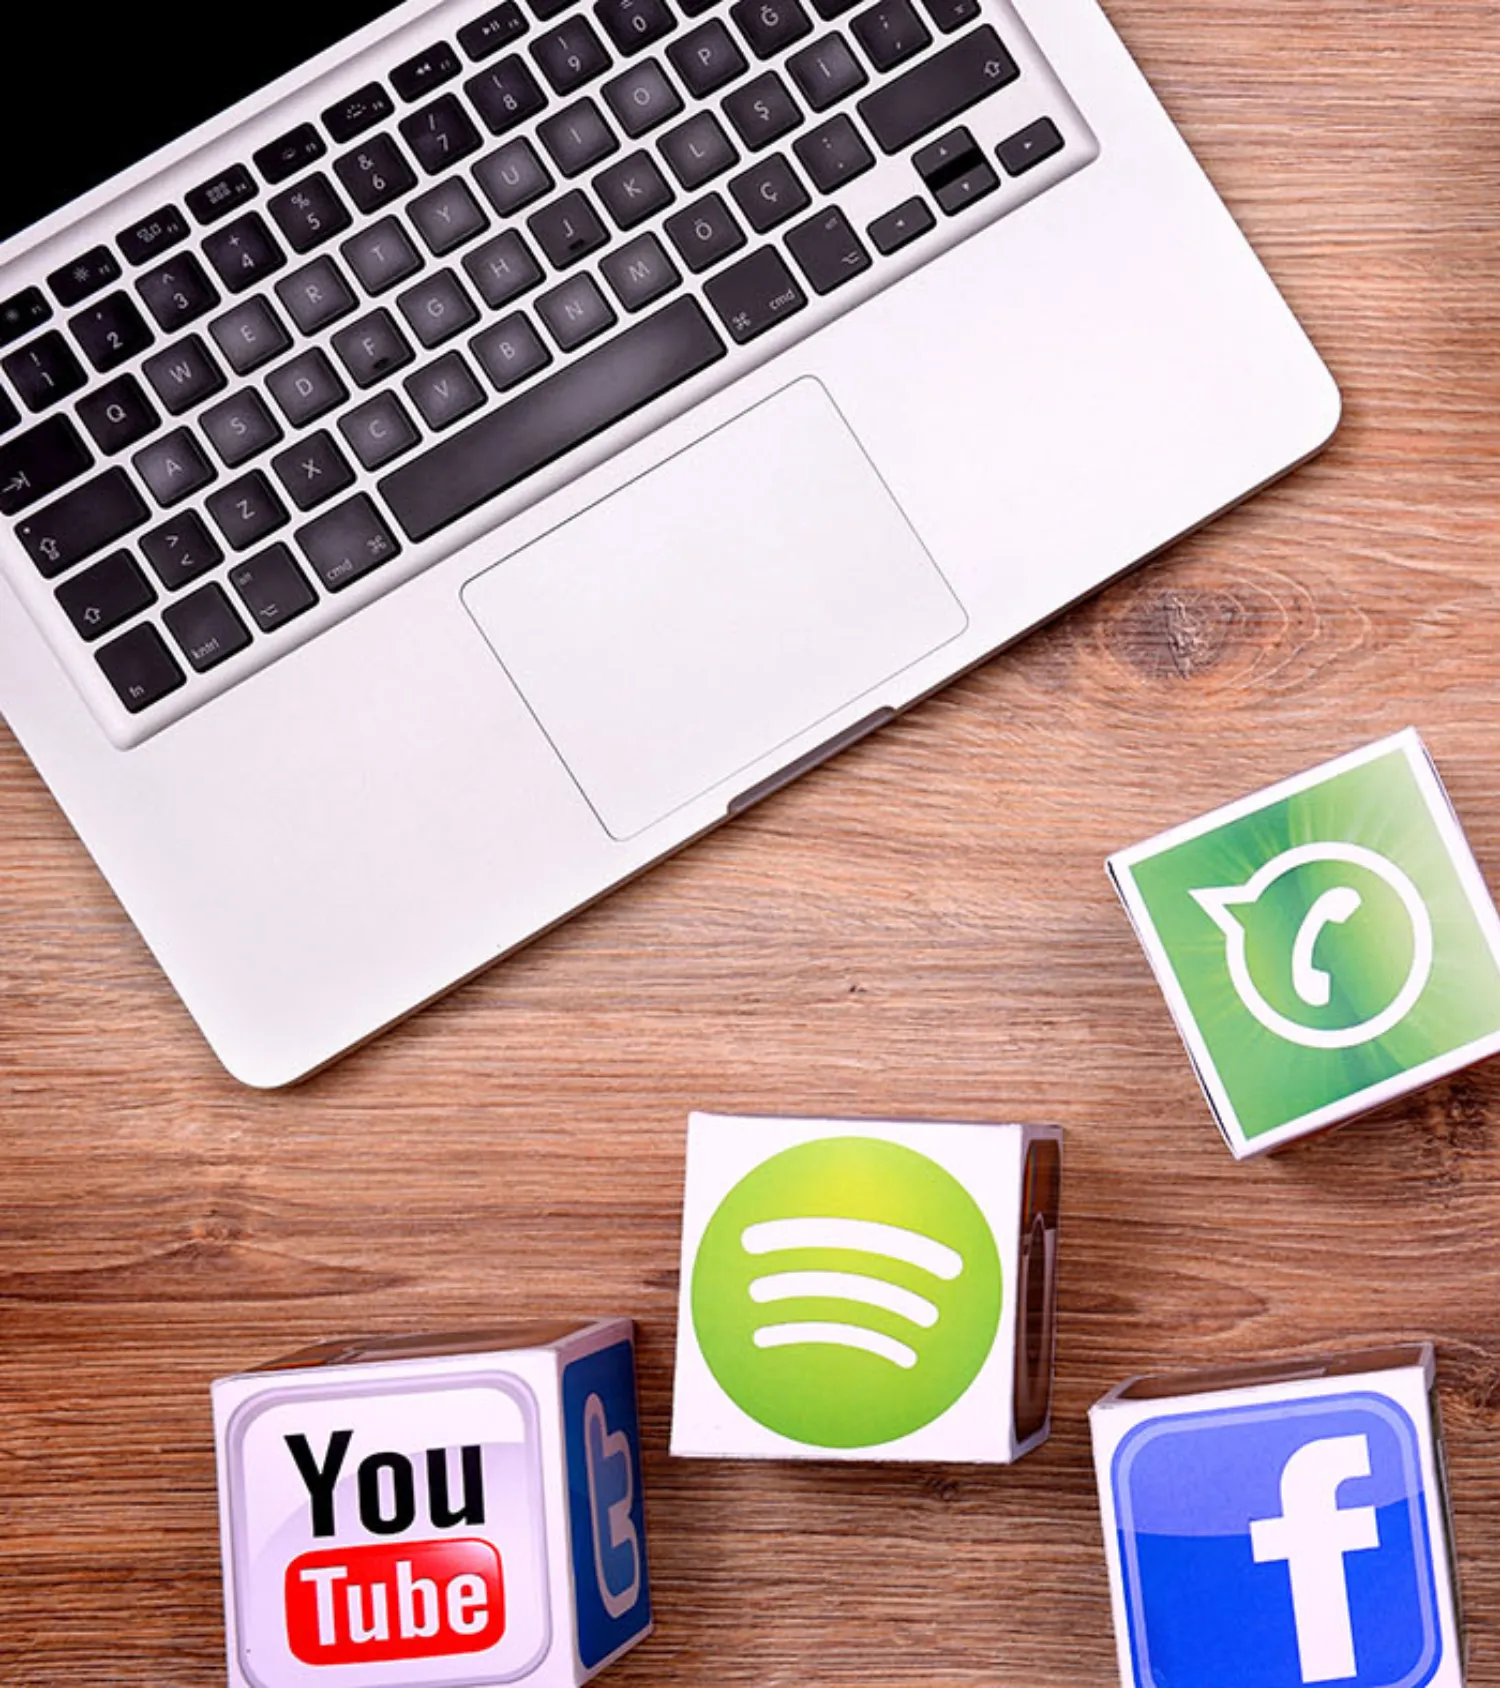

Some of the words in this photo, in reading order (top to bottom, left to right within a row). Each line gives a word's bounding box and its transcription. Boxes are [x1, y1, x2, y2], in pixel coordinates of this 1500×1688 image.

[567, 55, 581, 71] 9
[697, 47, 711, 66] P
[502, 93, 518, 110] 8
[436, 133, 449, 151] 7
[689, 143, 705, 158] L
[372, 174, 386, 190] 6
[501, 165, 520, 185] U
[623, 178, 642, 197] K
[306, 212, 321, 230] 5
[436, 206, 451, 223] Y
[563, 219, 574, 238] J
[241, 253, 255, 268] 4
[371, 245, 384, 261] T
[490, 258, 510, 278] H
[629, 260, 650, 282] M
[173, 292, 189, 309] 3
[305, 285, 323, 303] R
[427, 301, 445, 318] G
[564, 301, 584, 320] N
[106, 331, 123, 349] 2
[240, 324, 256, 343] E
[362, 337, 375, 356] F
[499, 342, 516, 360] B
[168, 361, 192, 384] W
[295, 378, 313, 397] D
[433, 379, 449, 398] V
[106, 404, 126, 423] Q
[229, 417, 247, 436] S
[368, 419, 387, 439] C
[165, 458, 182, 477] A
[301, 459, 322, 479] X
[236, 499, 255, 520] Z
[284, 1429, 485, 1538] You
[1249, 1433, 1381, 1684] f
[299, 1560, 489, 1647] Tube
